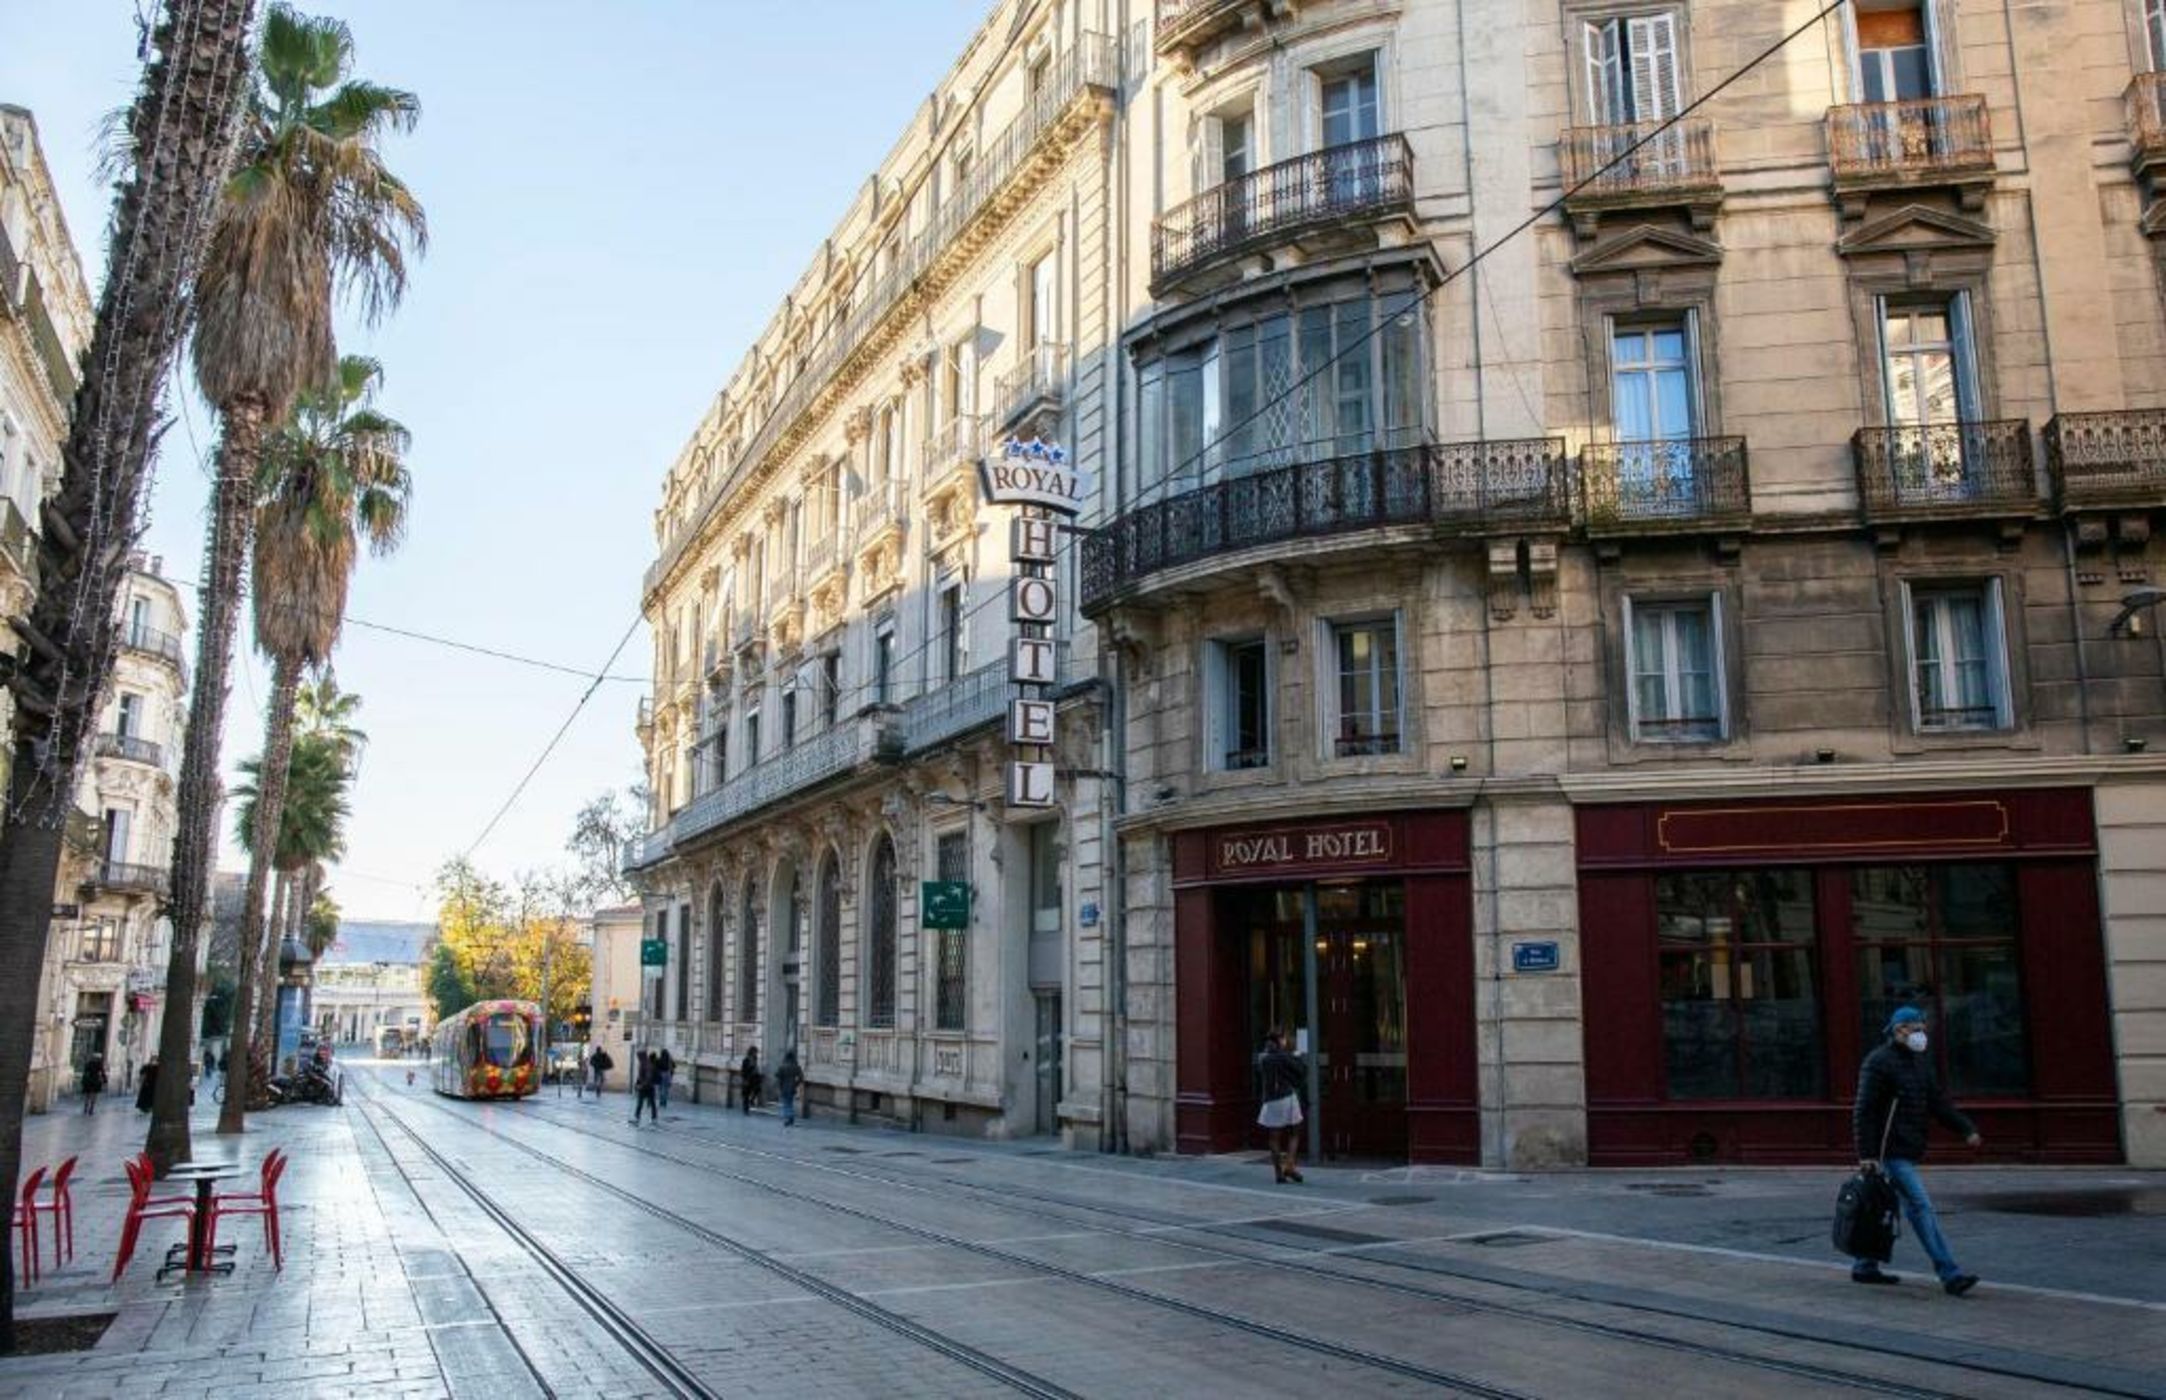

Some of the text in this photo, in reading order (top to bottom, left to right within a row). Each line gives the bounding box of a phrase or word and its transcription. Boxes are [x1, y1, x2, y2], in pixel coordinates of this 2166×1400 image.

[992, 466, 1083, 502] ROYAL
[1018, 520, 1054, 803] HOTEL
[1222, 830, 1385, 867] ROYAL HOTEL
